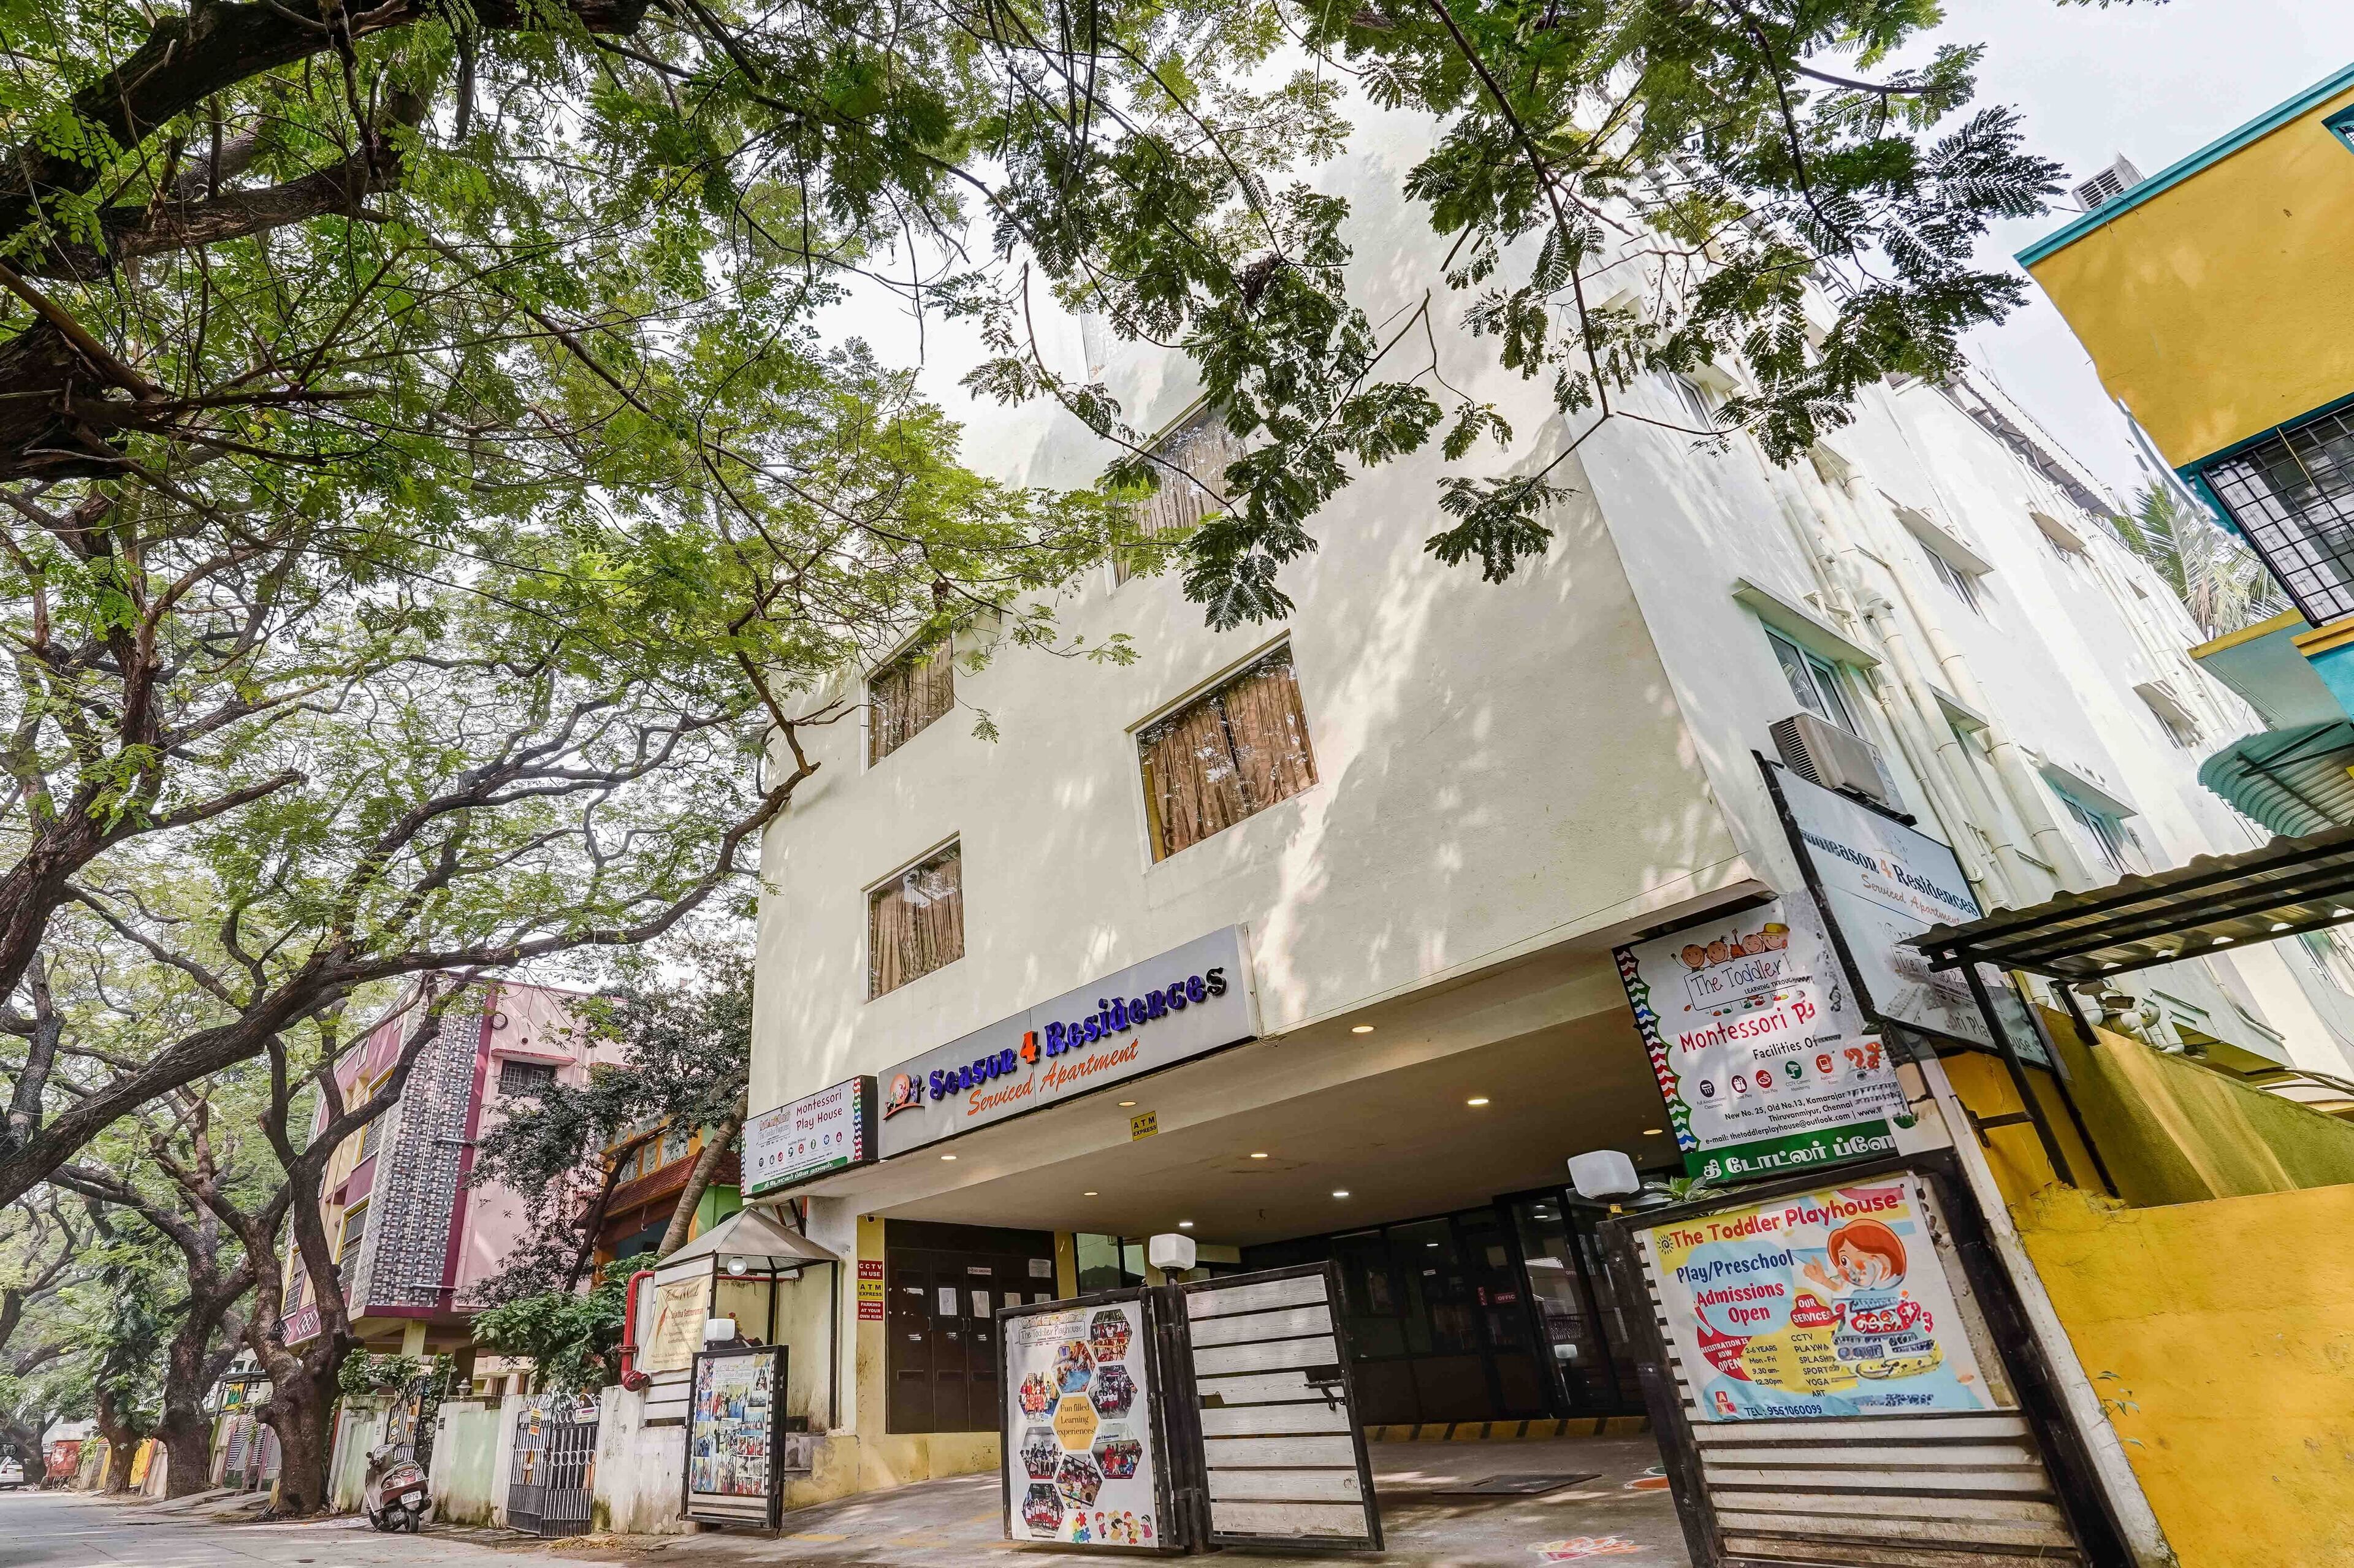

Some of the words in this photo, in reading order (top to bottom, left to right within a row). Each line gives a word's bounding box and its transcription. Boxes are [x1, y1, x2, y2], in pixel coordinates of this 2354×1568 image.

[1880, 858, 1894, 880] 4
[1891, 863, 1979, 916] Residences
[1861, 873, 1906, 904] Serviced
[1910, 896, 1960, 926] Apartment
[1690, 974, 1723, 996] The
[1721, 959, 1782, 988] Toddler
[1744, 983, 1770, 994] LEARNING
[929, 1047, 1018, 1101] Season
[1020, 1030, 1041, 1065] 4
[1044, 967, 1228, 1058] Residences
[1679, 1007, 1788, 1053] Montessori
[1753, 1041, 1802, 1060] Facilities
[967, 1077, 1034, 1116] Serviced
[1039, 1037, 1140, 1092] Apartment
[796, 1089, 842, 1117] Montessori
[1724, 1111, 1740, 1121] New
[1742, 1108, 1753, 1117] No.
[1754, 1106, 1767, 1116] 25,
[1767, 1103, 1780, 1113] Old
[1781, 1097, 1806, 1110] No.13,
[1806, 1091, 1846, 1105] Kamarajar
[796, 1116, 814, 1132] Play
[817, 1106, 843, 1124] House
[1768, 1109, 1822, 1124] Thiruvanmiyur,
[1133, 1125, 1157, 1136] EXPRESS
[1705, 1133, 1730, 1144] e-mail:
[1730, 1113, 1851, 1141] thetoddlerplayhouse@outlook.com
[1703, 1158, 1723, 1181] தி
[1725, 1140, 1827, 1174] டோட்லர்
[1670, 1229, 1704, 1249] The
[1707, 1216, 1780, 1243] Toddler
[1786, 1193, 1899, 1227] Playhouse
[1677, 1248, 1795, 1284] Play/Preschool
[1697, 1282, 1785, 1307] Admissions
[1798, 1298, 1817, 1309] OUR
[1728, 1304, 1771, 1326] Open
[1021, 1330, 1032, 1339] The
[1054, 1325, 1083, 1336] Playhouse
[1791, 1333, 1813, 1342] CCTV
[1699, 1338, 1740, 1354] REGISTRATION
[1717, 1350, 1732, 1358] NOW
[1718, 1357, 1741, 1372] OPEN
[1755, 1378, 1783, 1387] 12.30pm
[1811, 1389, 1826, 1398] ART
[1060, 1404, 1073, 1412] Fun
[1073, 1402, 1089, 1412] filled
[1767, 1404, 1822, 1415] 9551060099
[1061, 1416, 1089, 1425] Learning
[1057, 1426, 1096, 1437] experiences!
